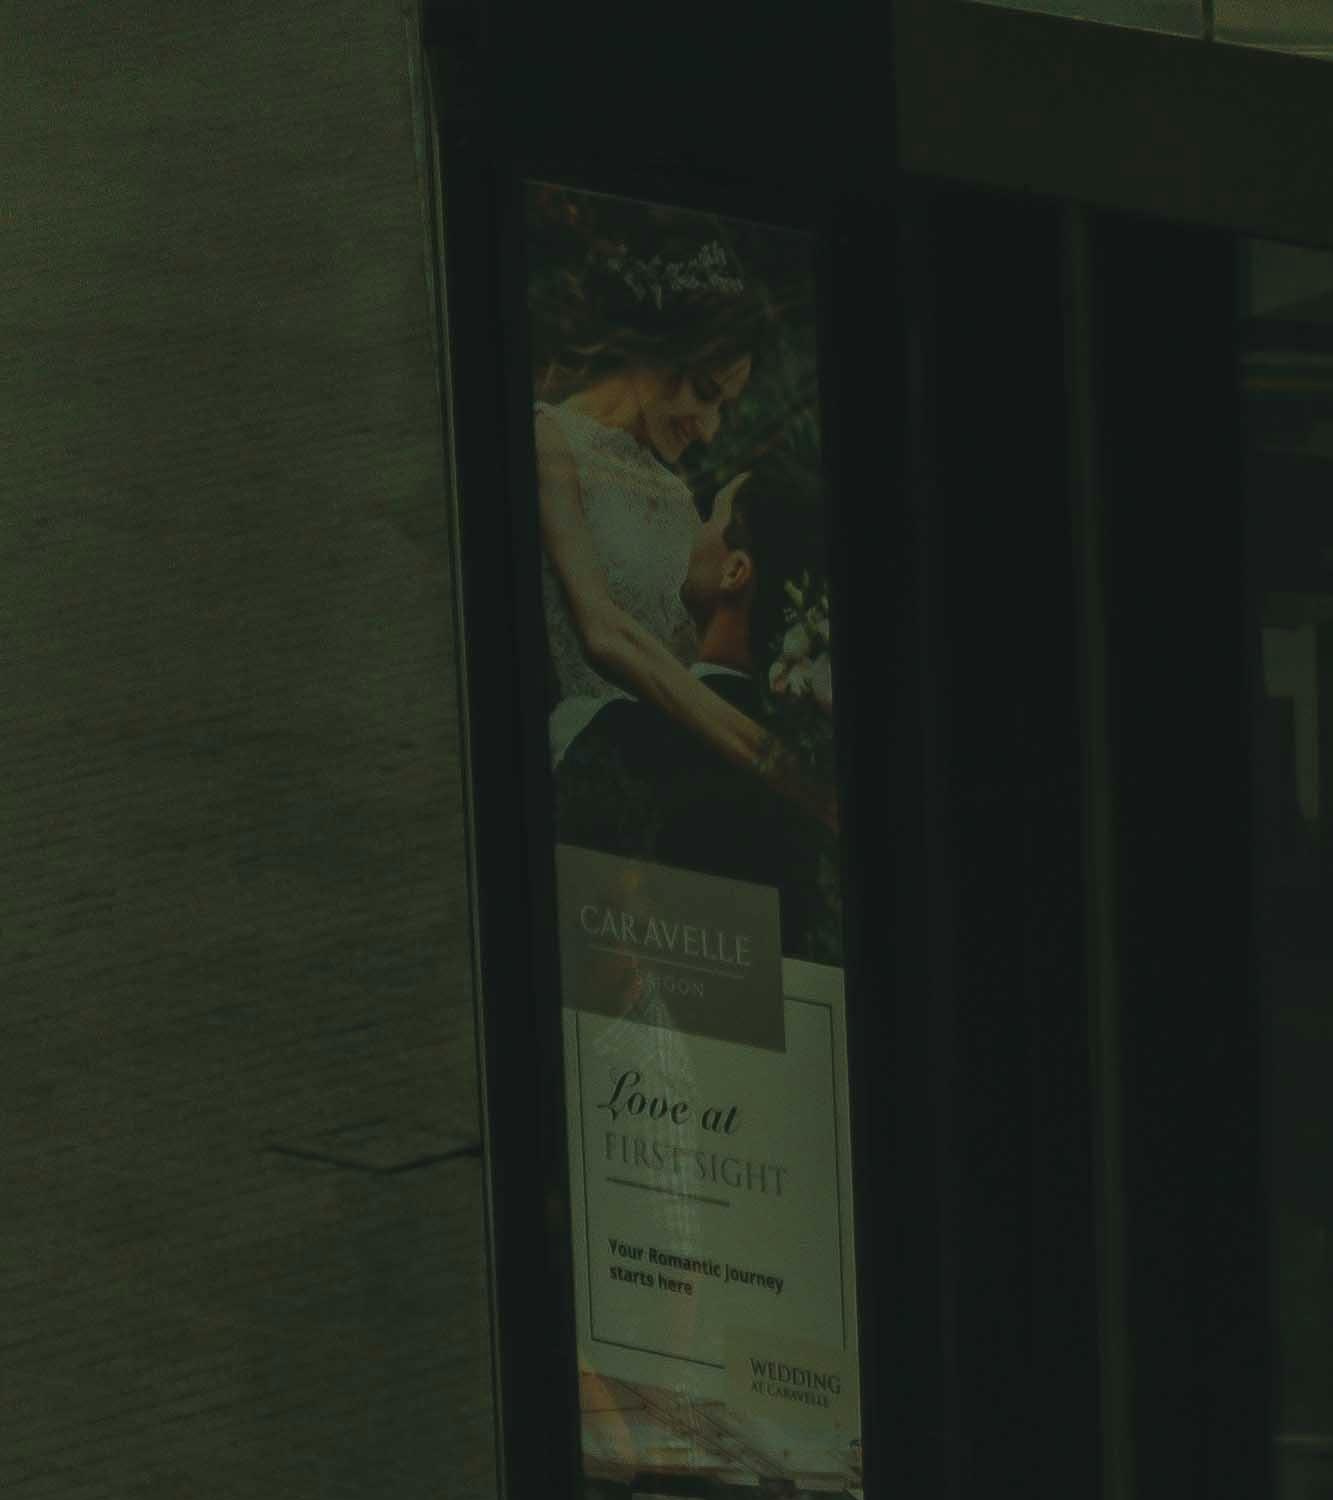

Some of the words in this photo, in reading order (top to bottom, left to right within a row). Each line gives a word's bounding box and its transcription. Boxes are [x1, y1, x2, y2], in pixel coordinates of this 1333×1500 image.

[579, 904, 753, 967] CARAVELLE
[597, 1070, 689, 1126] Love
[701, 1103, 738, 1136] at
[604, 1131, 691, 1176] FIRST
[694, 1151, 787, 1197] SIGHT
[608, 1239, 645, 1259] Your
[648, 1247, 721, 1279] Romantic
[724, 1263, 784, 1295] Journey
[609, 1265, 654, 1287] starts
[658, 1272, 694, 1296] here
[749, 1357, 841, 1394] WEDDING
